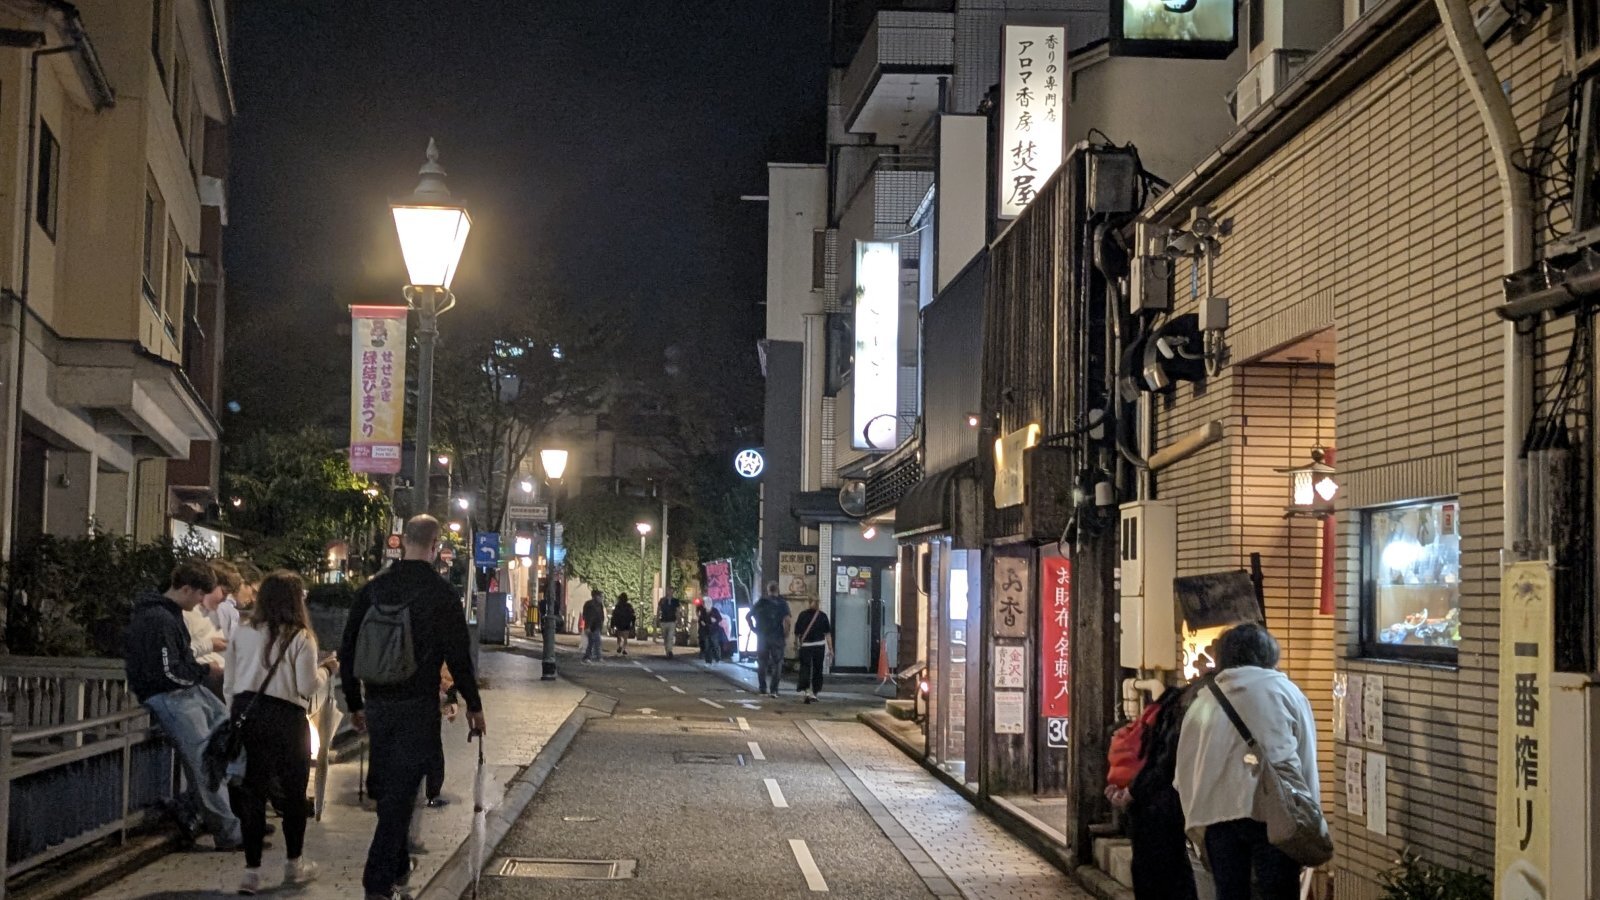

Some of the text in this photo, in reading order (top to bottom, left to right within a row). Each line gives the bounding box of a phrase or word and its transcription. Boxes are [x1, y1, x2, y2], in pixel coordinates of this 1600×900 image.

[1015, 40, 1035, 132] アロマ香房
[1044, 34, 1058, 123] 香りの専門店
[806, 565, 814, 574] P
[1009, 649, 1022, 684] 金沢の
[1513, 641, 1540, 851] 一番搾り
